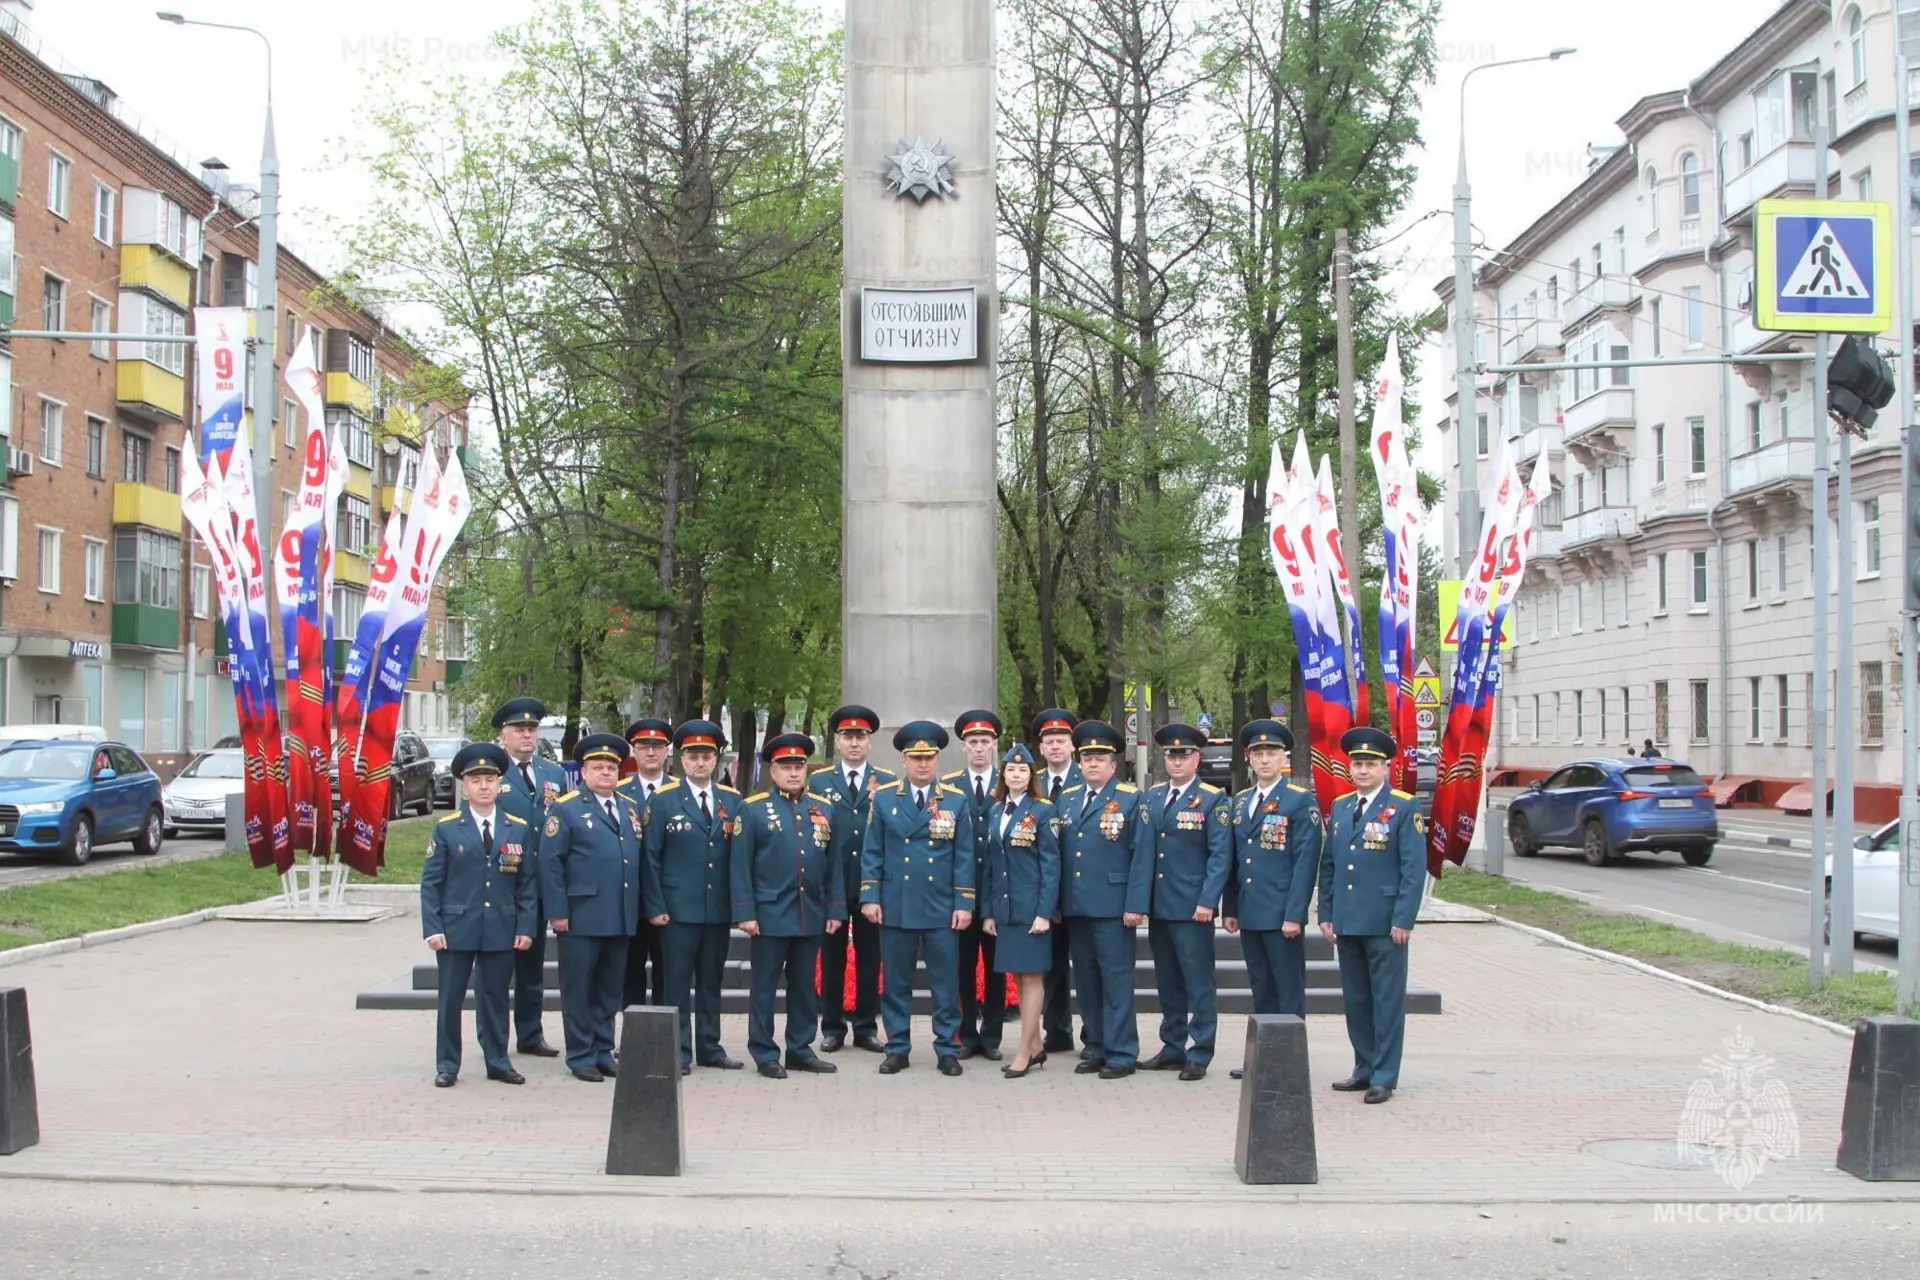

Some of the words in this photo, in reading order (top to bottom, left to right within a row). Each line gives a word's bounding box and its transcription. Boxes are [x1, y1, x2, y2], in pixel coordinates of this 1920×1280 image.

[871, 302, 967, 322] ОТСТОЯВШИМ
[874, 327, 962, 348] ОТЧИЗНУ
[214, 348, 233, 380] 9
[215, 382, 234, 391] МАЯ
[306, 430, 325, 486] 9
[305, 492, 322, 507] АЯ
[281, 530, 304, 578] 9
[249, 582, 264, 600] МА
[368, 586, 387, 603] АЯ
[72, 640, 102, 658] АПТЕКА
[393, 644, 400, 656] С
[1129, 718, 1137, 728] 4
[1418, 713, 1432, 723] 40
